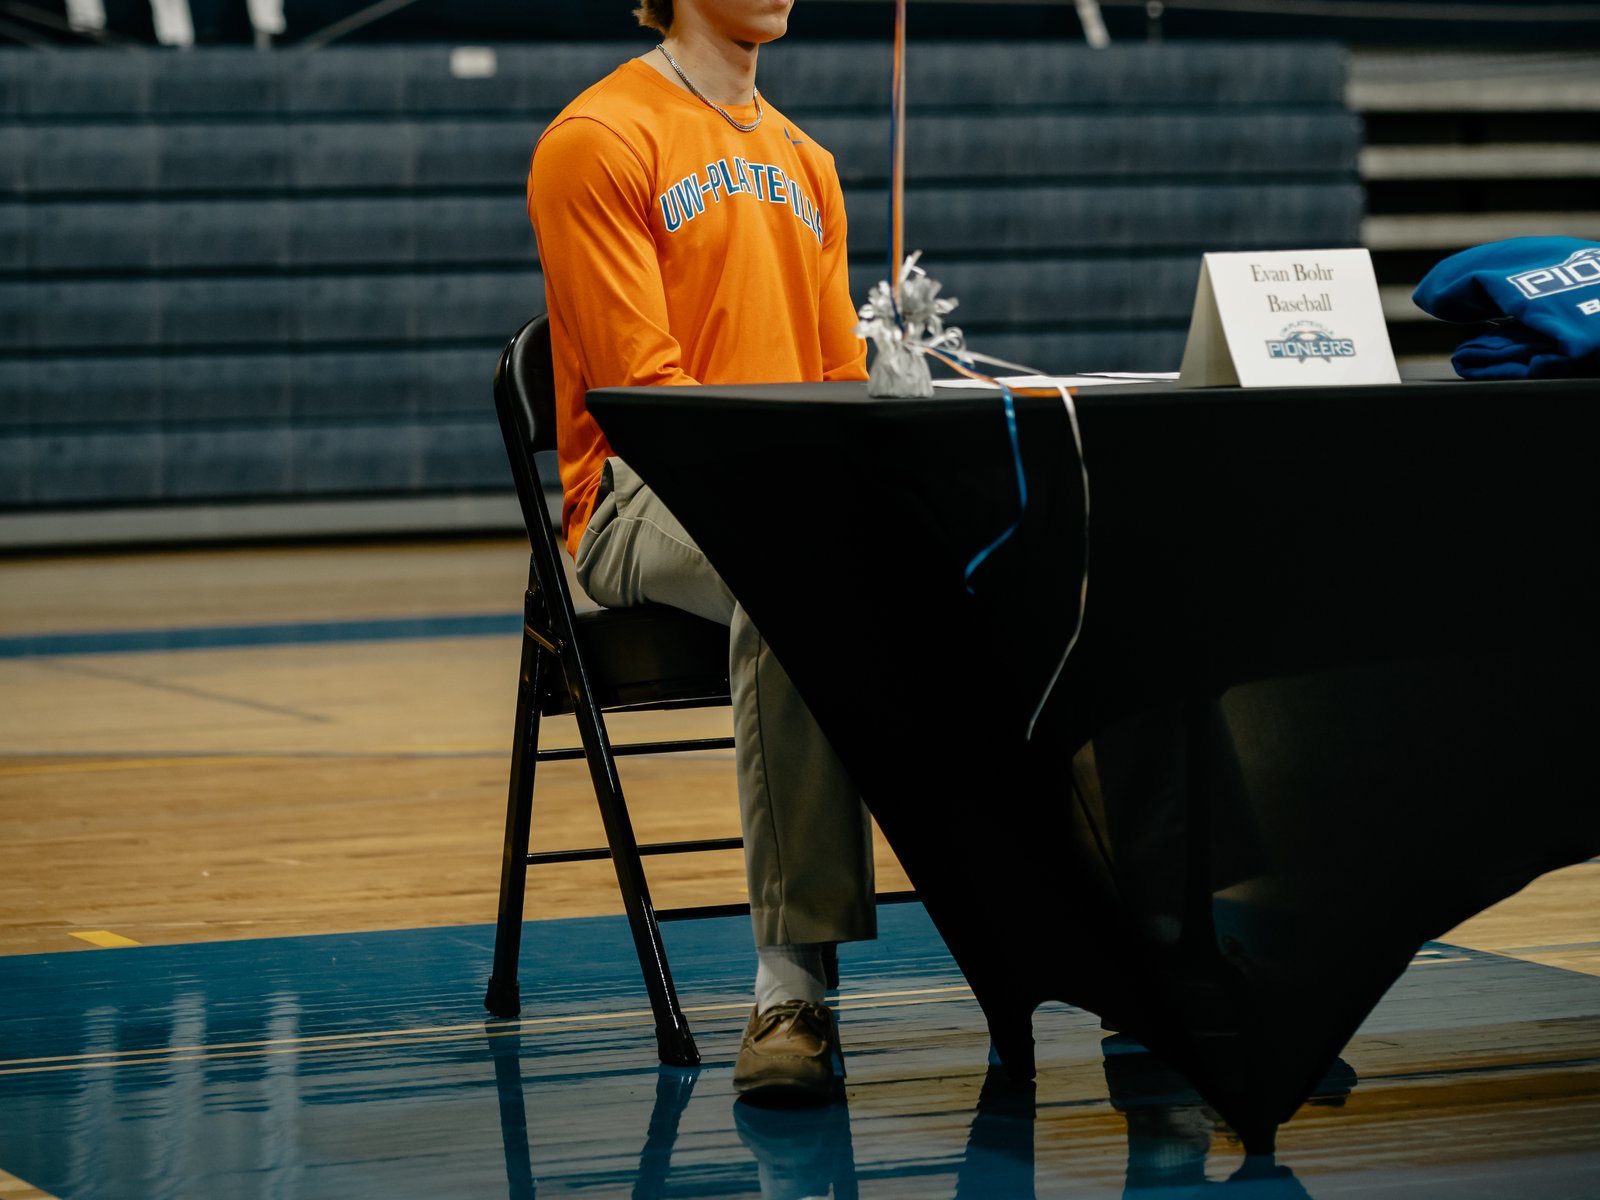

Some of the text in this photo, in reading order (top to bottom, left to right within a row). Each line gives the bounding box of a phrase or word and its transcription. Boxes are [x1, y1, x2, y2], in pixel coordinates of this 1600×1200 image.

[1250, 263, 1334, 282] Evan Bohr
[1267, 293, 1333, 312] Baseball
[1267, 341, 1355, 357] PIONEERS
